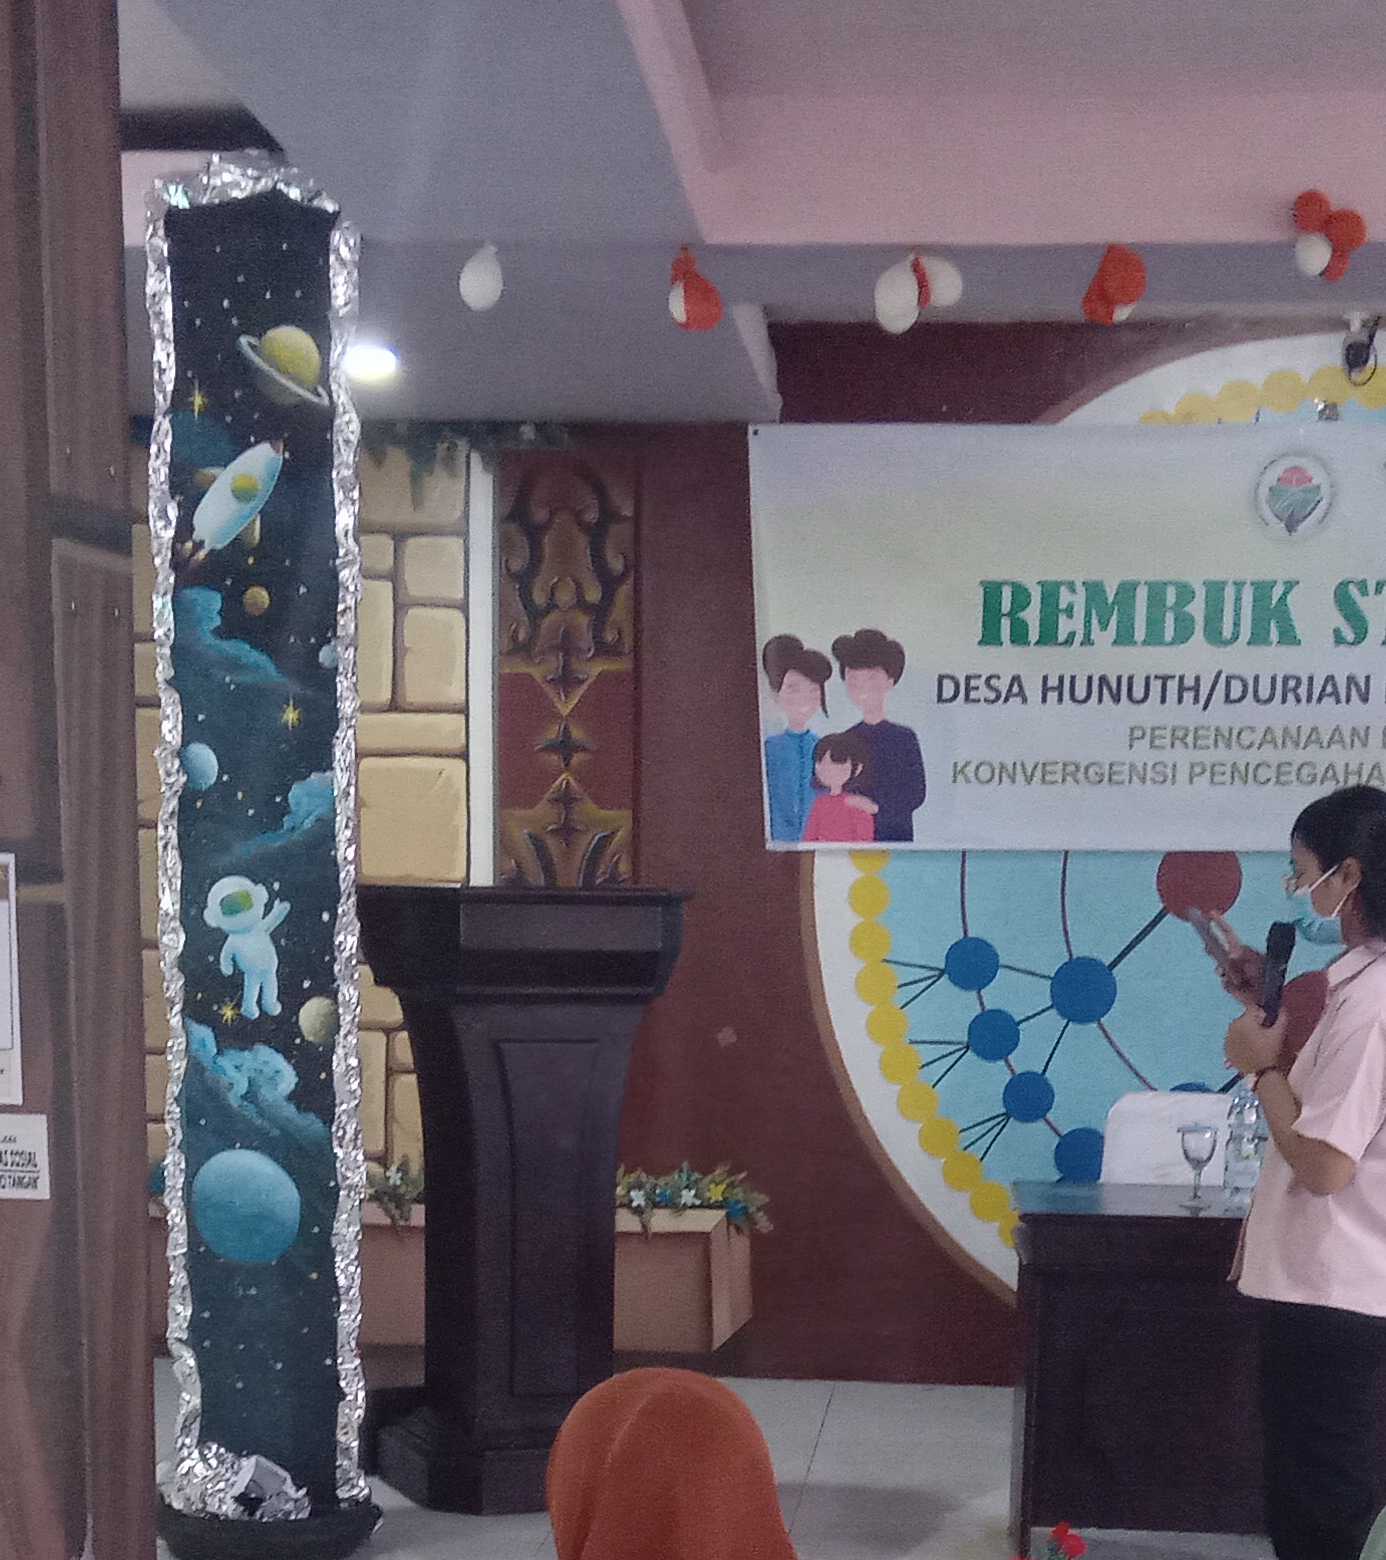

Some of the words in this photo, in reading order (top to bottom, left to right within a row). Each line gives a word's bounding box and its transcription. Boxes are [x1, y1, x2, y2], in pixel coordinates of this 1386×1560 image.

[977, 578, 1303, 648] REMBUK
[936, 673, 1028, 705] DESA
[1040, 669, 1371, 712] HUNUTH/DURIAN
[1128, 724, 1370, 751] PERENCANAAN
[950, 759, 1178, 786] KONVERGENSI
